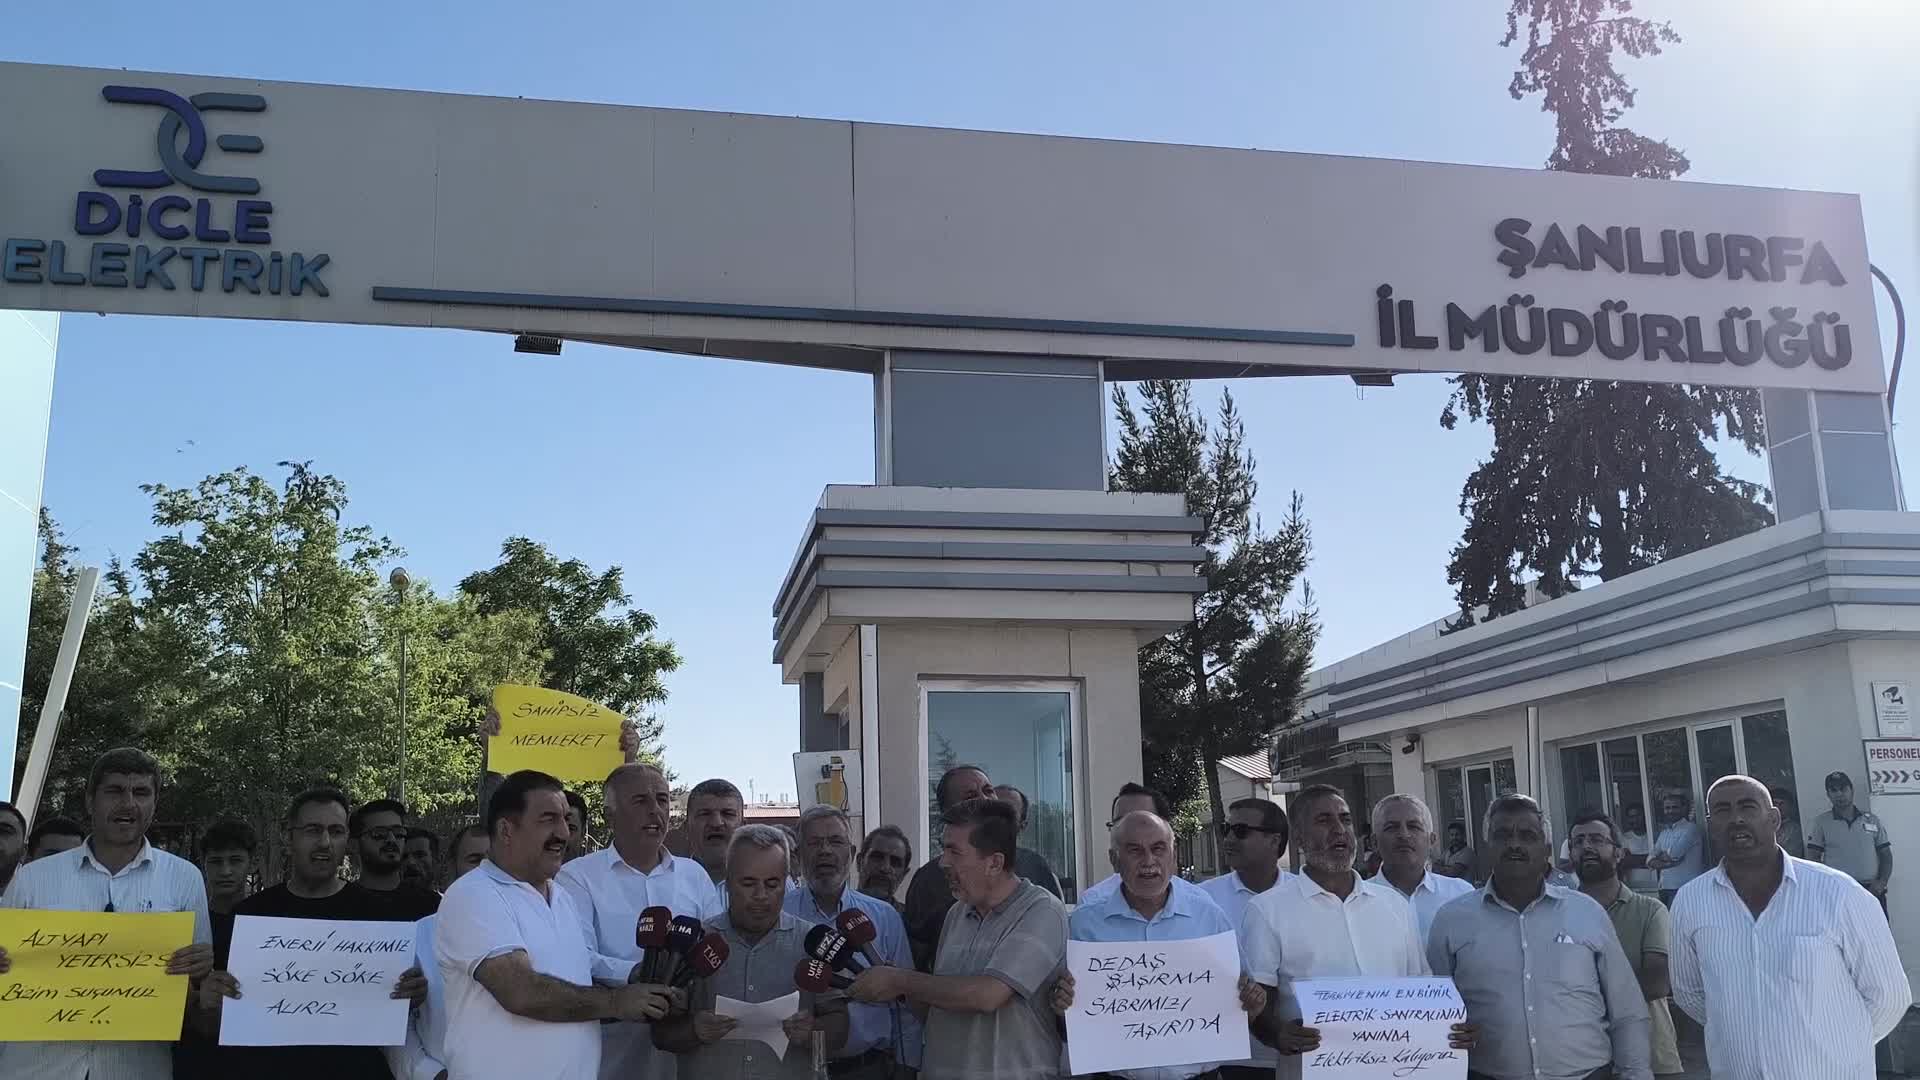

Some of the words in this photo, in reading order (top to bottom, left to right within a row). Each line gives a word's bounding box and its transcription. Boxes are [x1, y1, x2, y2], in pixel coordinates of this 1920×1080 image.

[1494, 217, 1848, 287] ŞANLIURFA
[1376, 283, 1439, 349] İL
[1446, 293, 1853, 371] MÜDÜRLÜĞÜ
[512, 699, 600, 719] SAHİPSİZ
[510, 733, 609, 748] MEMLEKET
[331, 938, 411, 954] HAKKIMIZ
[261, 961, 319, 984] SÖKE
[324, 963, 385, 984] SÖKE
[1087, 952, 1168, 973] DEDAŞ
[1105, 970, 1216, 992] ŞAŞIRMA
[266, 998, 340, 1015] ALIRIZ
[1085, 996, 1192, 1016] SABRIMIZI
[1352, 1028, 1412, 1043] YANINDA
